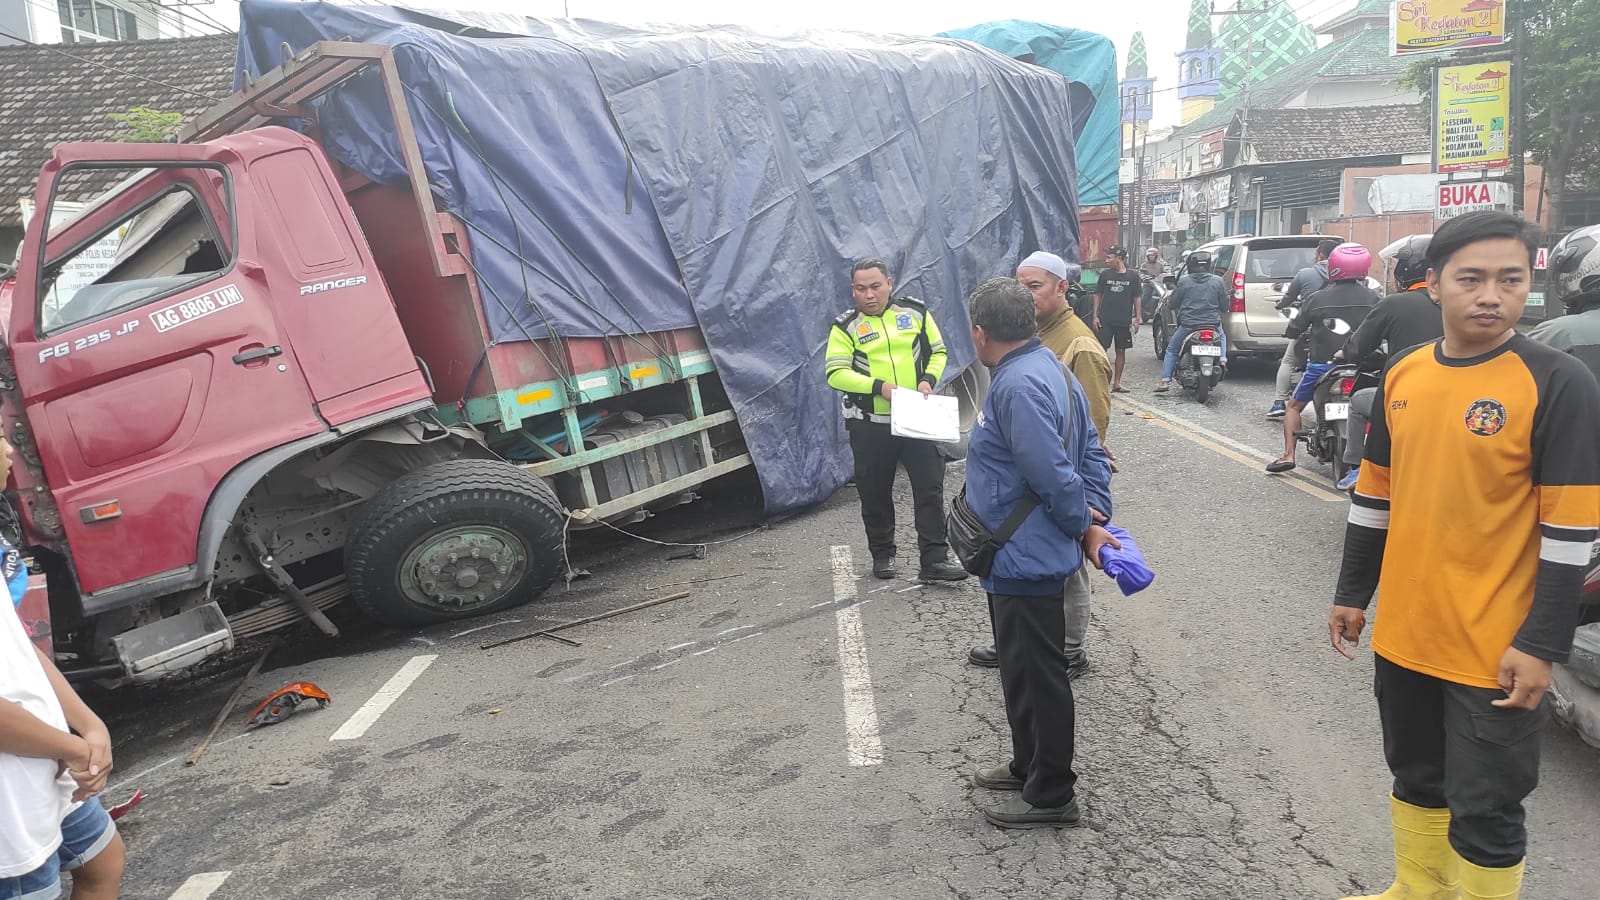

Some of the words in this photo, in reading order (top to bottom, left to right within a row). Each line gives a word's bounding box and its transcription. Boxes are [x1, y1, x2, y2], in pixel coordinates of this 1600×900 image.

[1399, 1, 1427, 21] Sri
[1479, 10, 1489, 26] 2
[1442, 72, 1459, 86] Sri
[1446, 117, 1472, 126] LESEHAN
[1446, 134, 1479, 143] MUSHOLLA
[1446, 143, 1467, 151] KOLAM
[1446, 151, 1470, 159] MAINAN
[1440, 184, 1491, 206] BUKA
[300, 275, 367, 296] RANGER
[156, 309, 180, 330] AG
[180, 298, 216, 320] 8806
[216, 287, 240, 307] UM
[38, 341, 70, 364] FG
[75, 330, 112, 351] 235
[116, 319, 140, 336] JP
